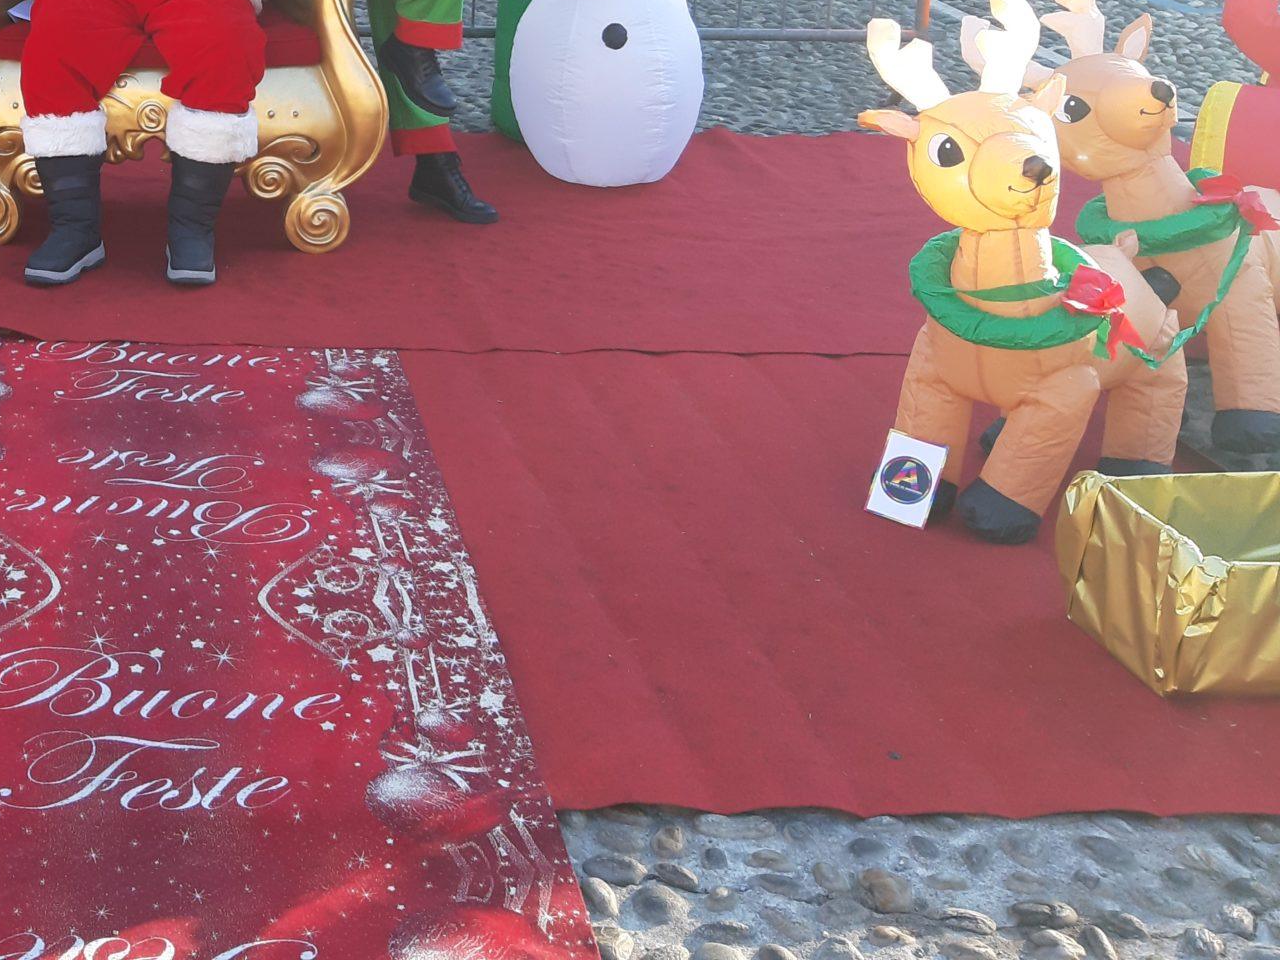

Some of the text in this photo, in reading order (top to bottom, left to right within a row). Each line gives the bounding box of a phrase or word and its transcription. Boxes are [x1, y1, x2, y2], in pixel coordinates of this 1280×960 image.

[29, 341, 280, 365] Buone
[54, 369, 245, 404] Feste
[56, 447, 265, 494] Feste
[6, 493, 318, 545] Buone
